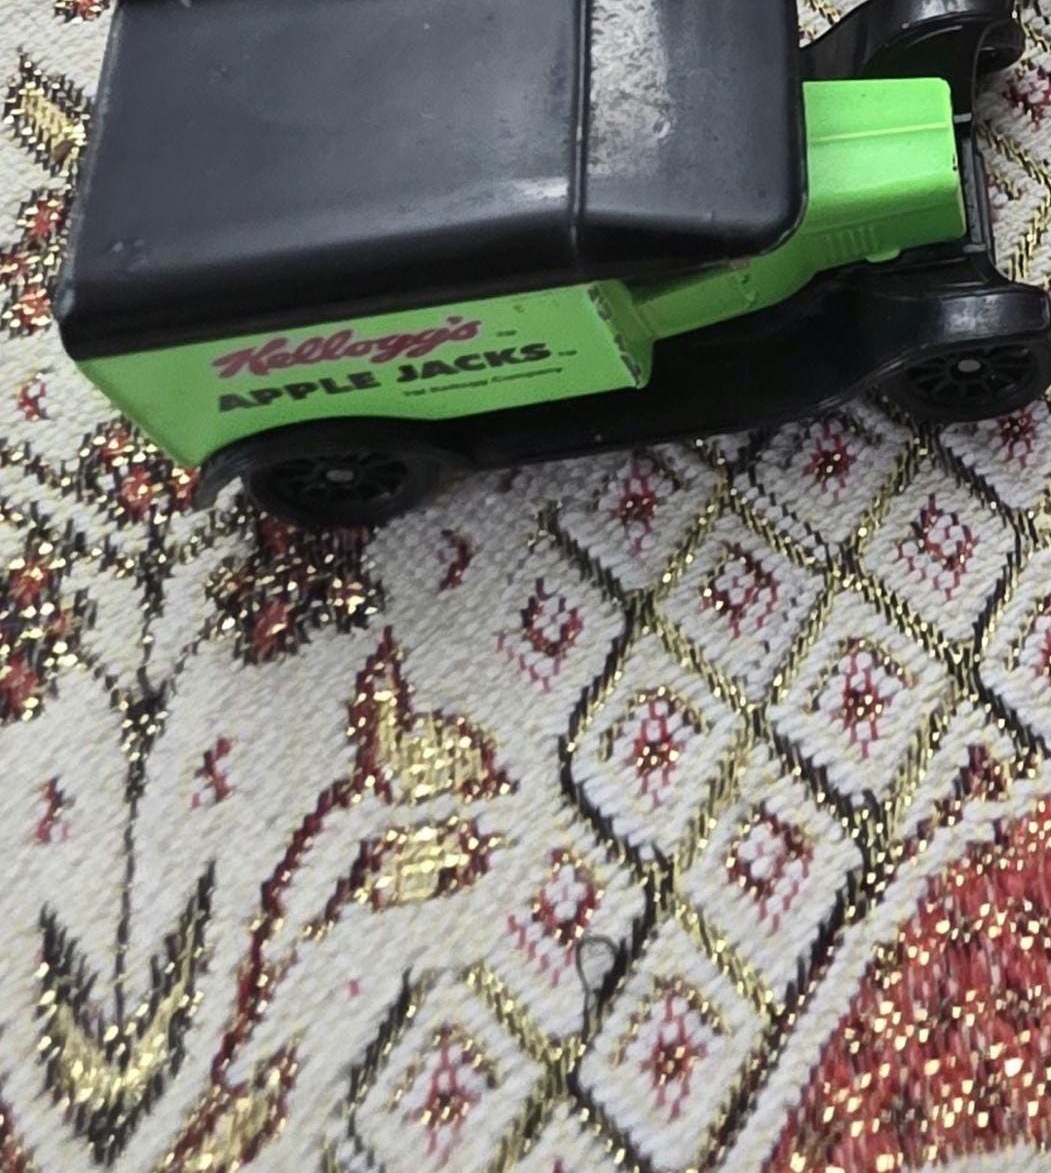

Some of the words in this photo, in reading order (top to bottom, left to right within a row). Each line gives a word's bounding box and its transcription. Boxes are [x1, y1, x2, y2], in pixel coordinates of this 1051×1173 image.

[211, 316, 484, 379] Kellogg's
[217, 370, 383, 414] APPLE
[396, 342, 552, 383] JACKS
